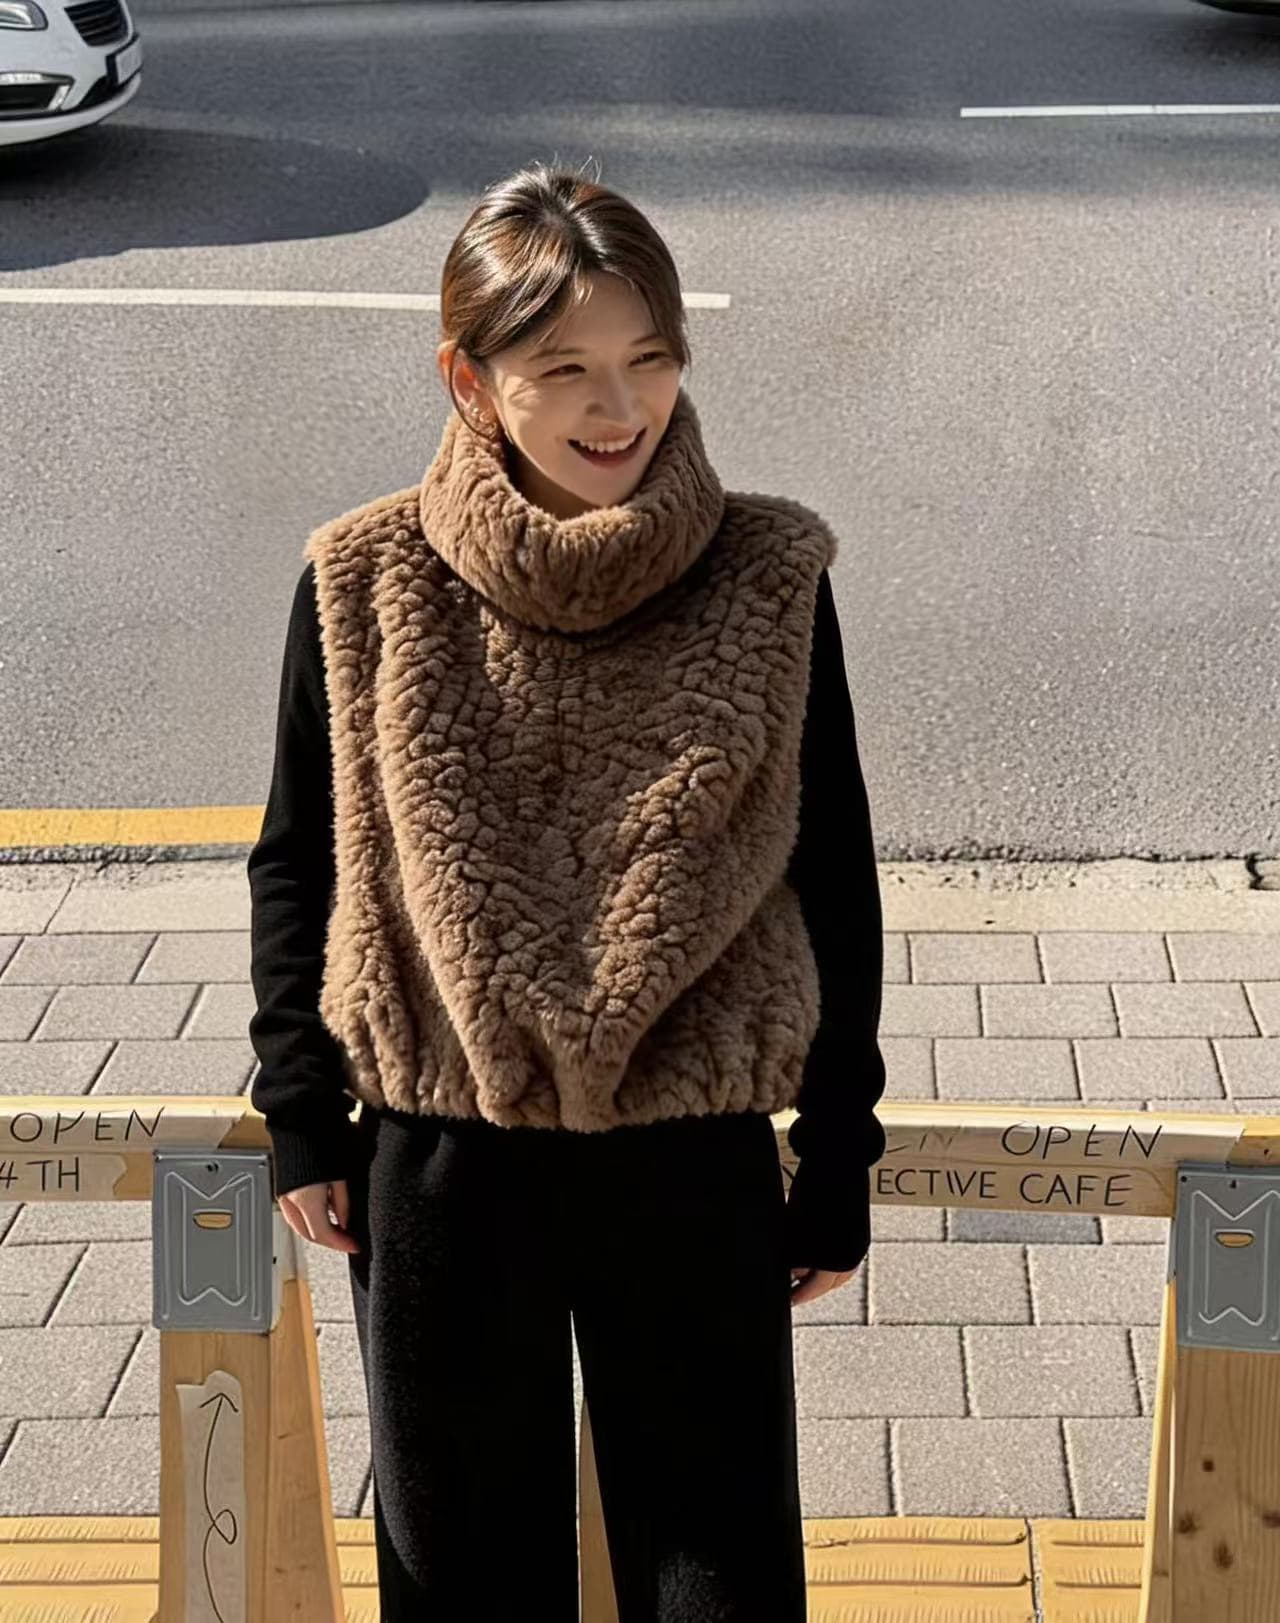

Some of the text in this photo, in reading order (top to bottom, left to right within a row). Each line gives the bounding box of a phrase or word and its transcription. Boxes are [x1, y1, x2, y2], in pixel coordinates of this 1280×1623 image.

[10, 1106, 165, 1144] OPEN
[1001, 1121, 1163, 1160] OPEN
[1020, 1173, 1133, 1207] CAFE
